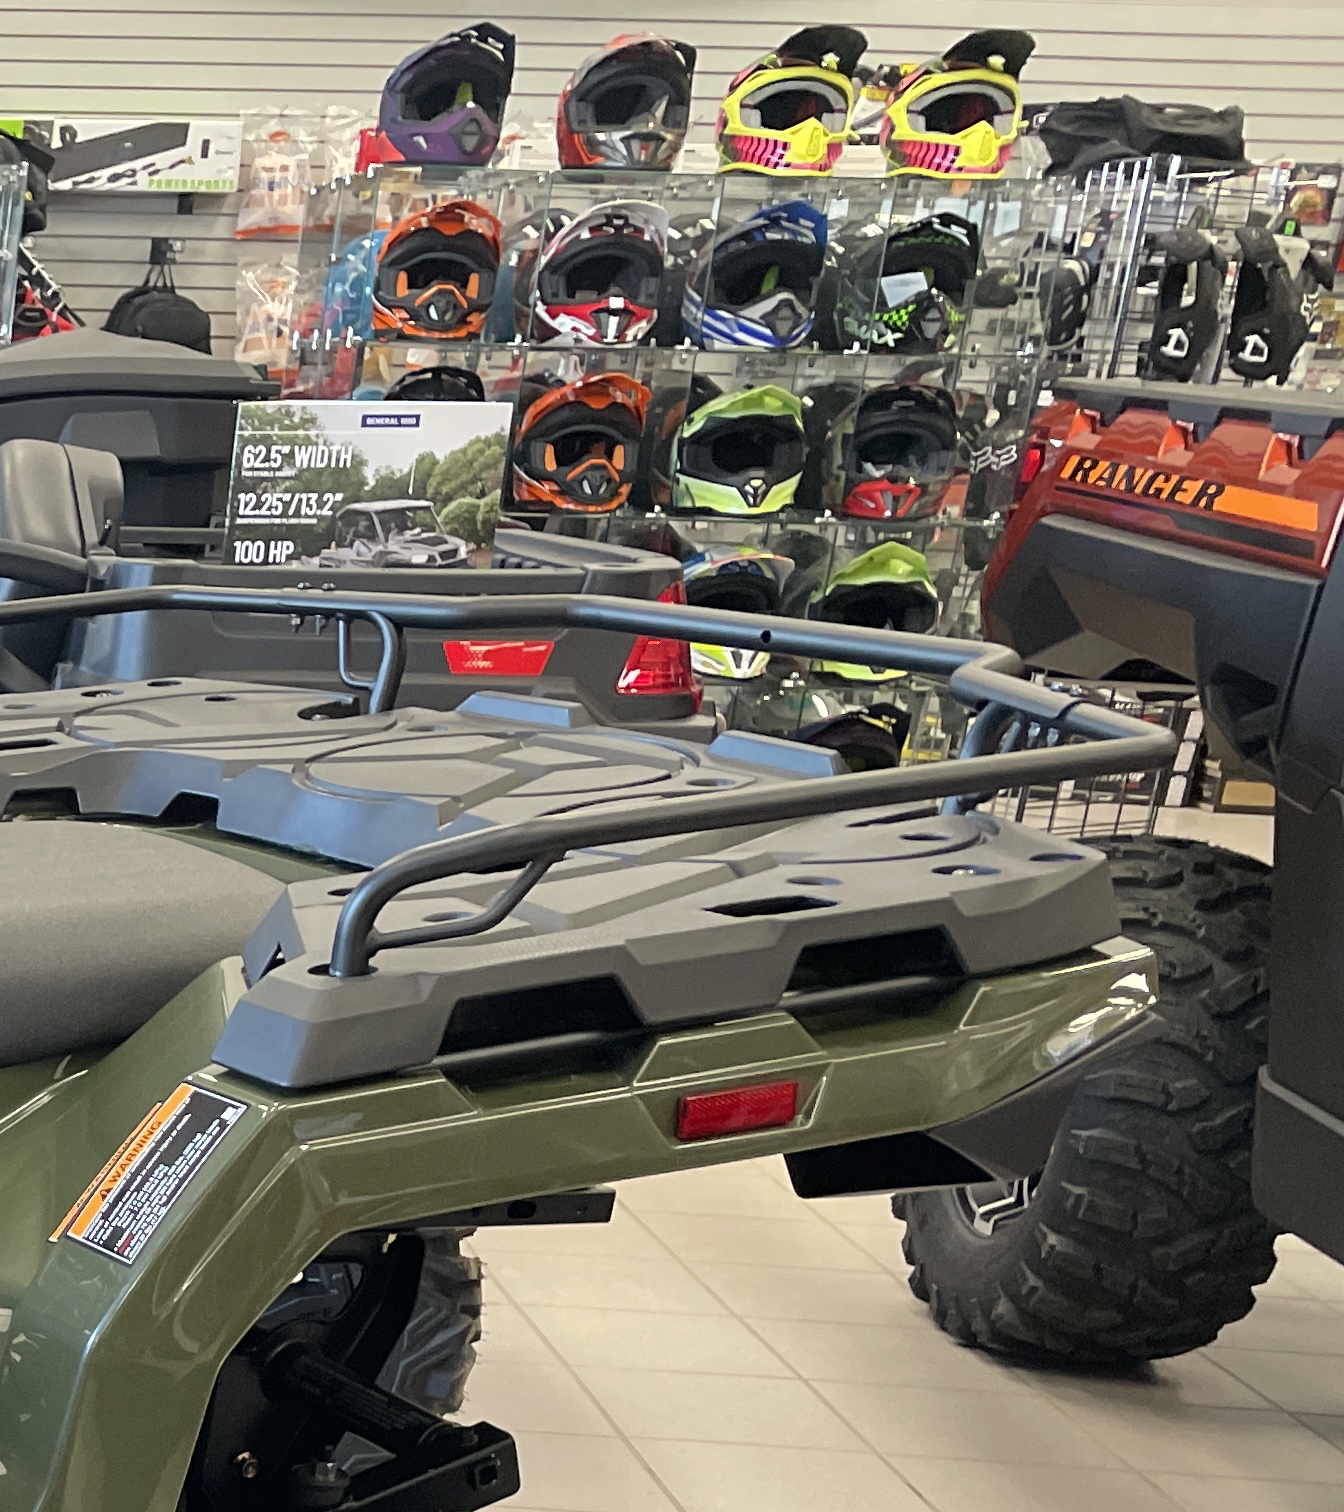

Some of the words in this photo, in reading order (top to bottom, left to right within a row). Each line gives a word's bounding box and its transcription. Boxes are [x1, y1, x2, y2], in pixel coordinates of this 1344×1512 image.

[148, 178, 236, 190] POWERSPORTS
[242, 445, 291, 468] 62.5"
[294, 445, 353, 469] WIDTH
[1068, 455, 1226, 512] RANGER
[233, 541, 265, 564] 100
[269, 540, 295, 564] HP
[107, 1120, 163, 1184] WARNING
